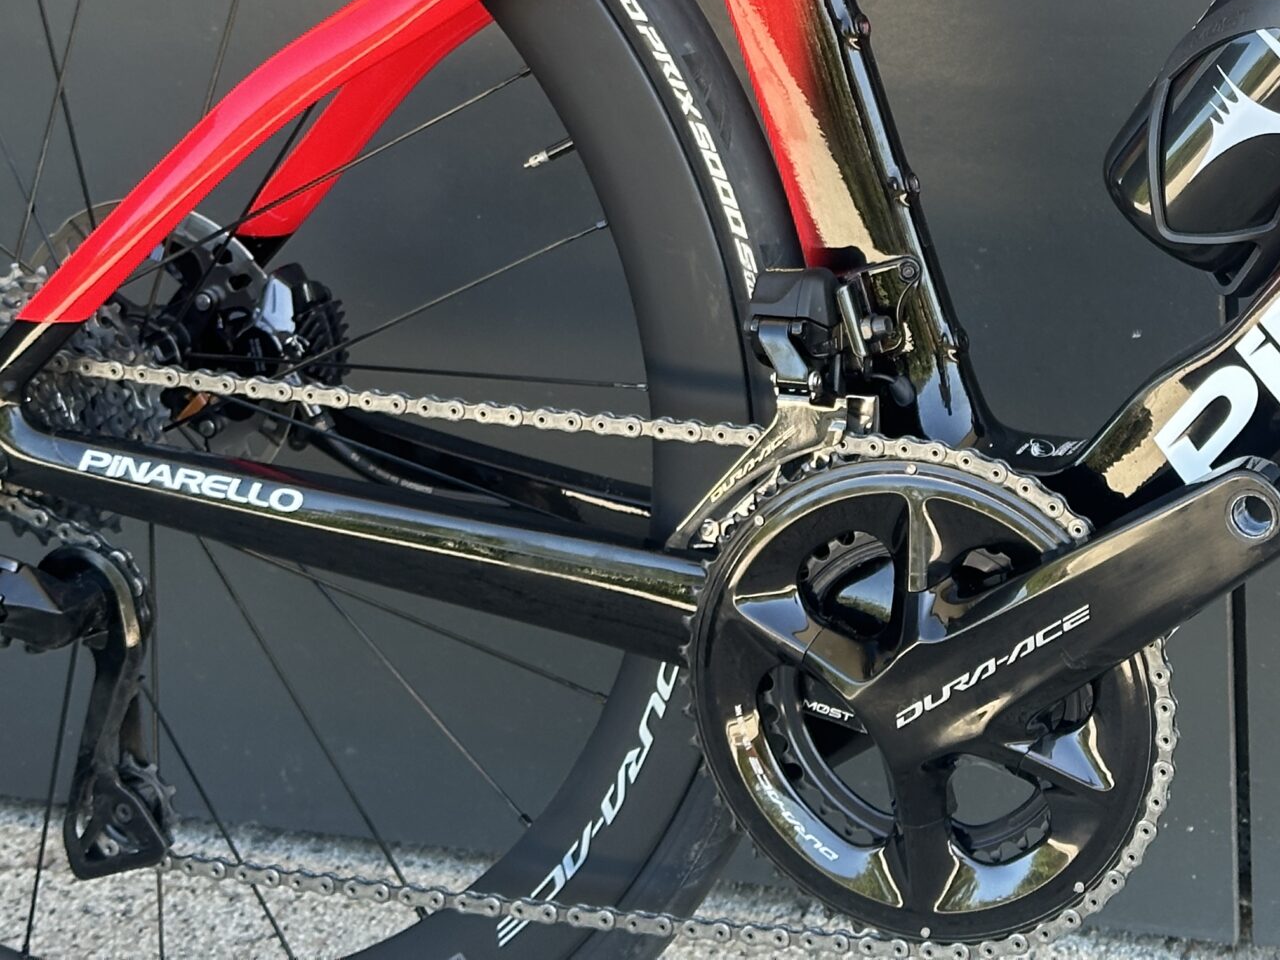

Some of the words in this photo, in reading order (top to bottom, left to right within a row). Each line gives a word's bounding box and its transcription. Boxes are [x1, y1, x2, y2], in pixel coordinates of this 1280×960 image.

[636, 24, 703, 119] PRIX
[77, 449, 304, 513] PINARELLO
[710, 424, 798, 503] DURA-ACE
[895, 603, 1091, 730] DURA-ACE
